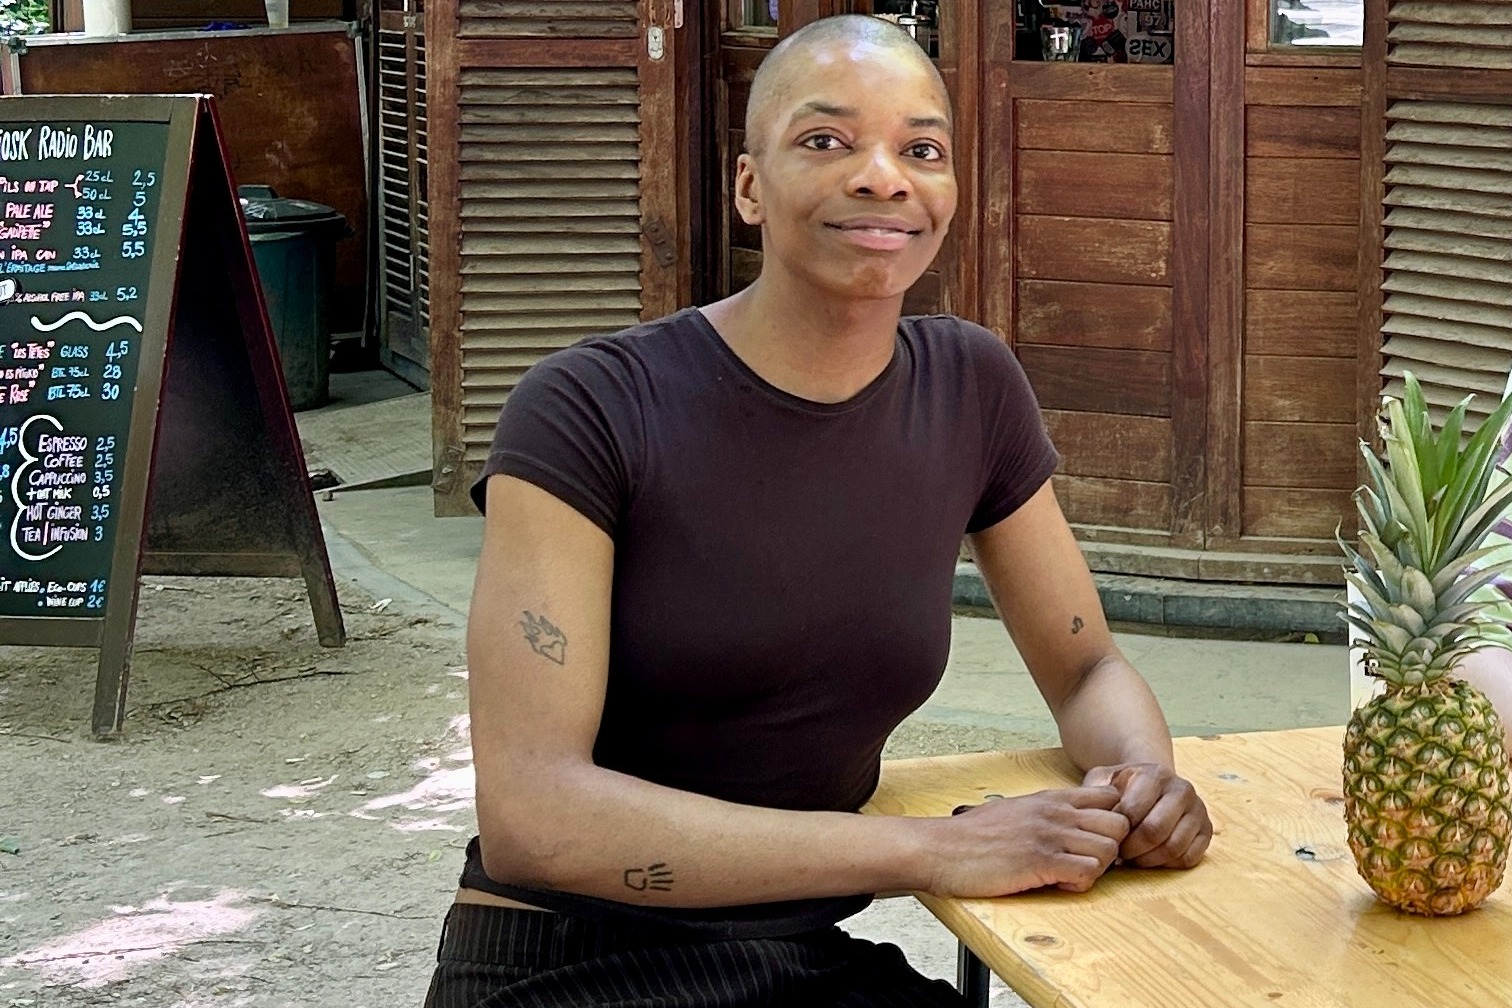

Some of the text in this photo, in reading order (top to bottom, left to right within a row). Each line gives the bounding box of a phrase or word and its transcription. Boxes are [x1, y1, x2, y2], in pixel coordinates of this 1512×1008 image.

[1129, 39, 1167, 57] SEX
[0, 128, 33, 160] OSK
[83, 124, 114, 161] BAR
[39, 180, 59, 193] TAP
[132, 170, 156, 190] 2,5
[132, 191, 146, 206] 5
[5, 202, 31, 219] PALE
[32, 203, 54, 219] ALE
[127, 207, 145, 226] 4
[122, 221, 147, 237] 5,5
[35, 249, 56, 260] CAN
[121, 241, 145, 259] 5,5
[51, 292, 70, 302] FREE
[117, 286, 138, 302] 5,2
[60, 345, 89, 358] GLASS
[106, 340, 129, 363] 4,5
[103, 364, 122, 379] 28
[47, 385, 66, 400] BTL
[101, 382, 120, 400] 30
[38, 434, 115, 452] ESPRESSO 2,5
[44, 453, 114, 468] COFFEE 2,5
[93, 470, 114, 484] 3,5
[92, 485, 111, 500] 0,5
[26, 502, 48, 521] HOT
[90, 504, 110, 522] 3,5
[94, 526, 104, 541] 3
[90, 579, 106, 593] 1€
[68, 597, 85, 607] CUP
[87, 595, 105, 608] 2€
